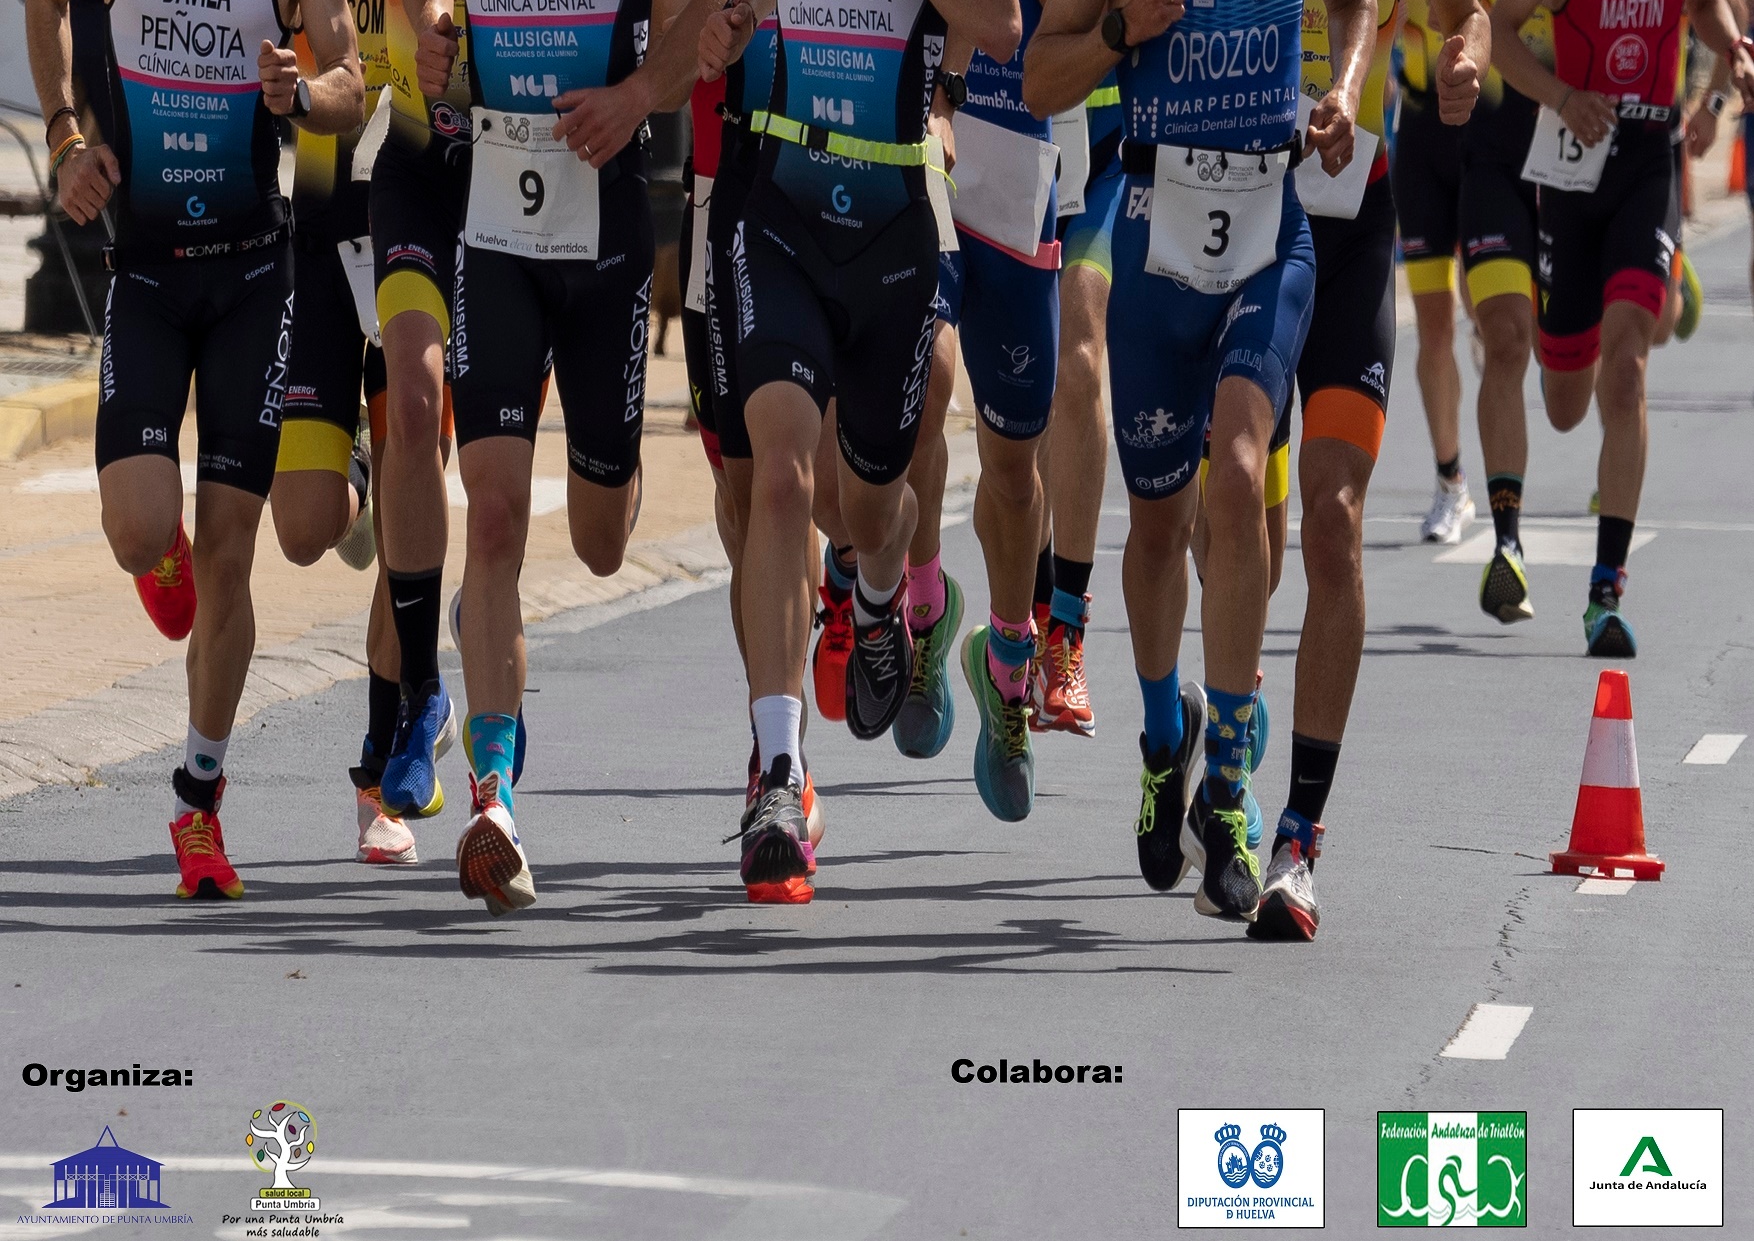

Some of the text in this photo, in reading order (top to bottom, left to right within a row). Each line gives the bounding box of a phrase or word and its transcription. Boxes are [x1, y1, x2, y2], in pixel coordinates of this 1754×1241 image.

[789, 2, 894, 32] CLÍNICA DENTAL
[141, 10, 245, 58] PEÑOTA
[493, 31, 579, 47] ALUSIGMA
[138, 53, 247, 81] CLÍNICA DENTAL
[800, 46, 875, 71] ALUSIGMA
[1168, 24, 1279, 84] OROZCO
[151, 91, 230, 112] ALUSIGMA
[1165, 86, 1296, 117] MARPEDENTAL
[1165, 108, 1296, 136] Clínica Dental Los Remedios
[162, 168, 226, 183] GSPORT
[518, 169, 546, 217] 9
[475, 232, 508, 247] Huelva
[535, 243, 549, 254] tus
[1202, 209, 1231, 258] 3
[408, 244, 434, 260] ENERGY
[456, 275, 470, 378] ALUSIGMA
[624, 274, 652, 423] PEÑOTA
[708, 287, 729, 397] ALUSIGMA
[103, 314, 116, 403] ALUSIGMA
[258, 289, 295, 429] PEÑOTA
[288, 385, 317, 396] ENERGY
[1152, 461, 1189, 488] EDM
